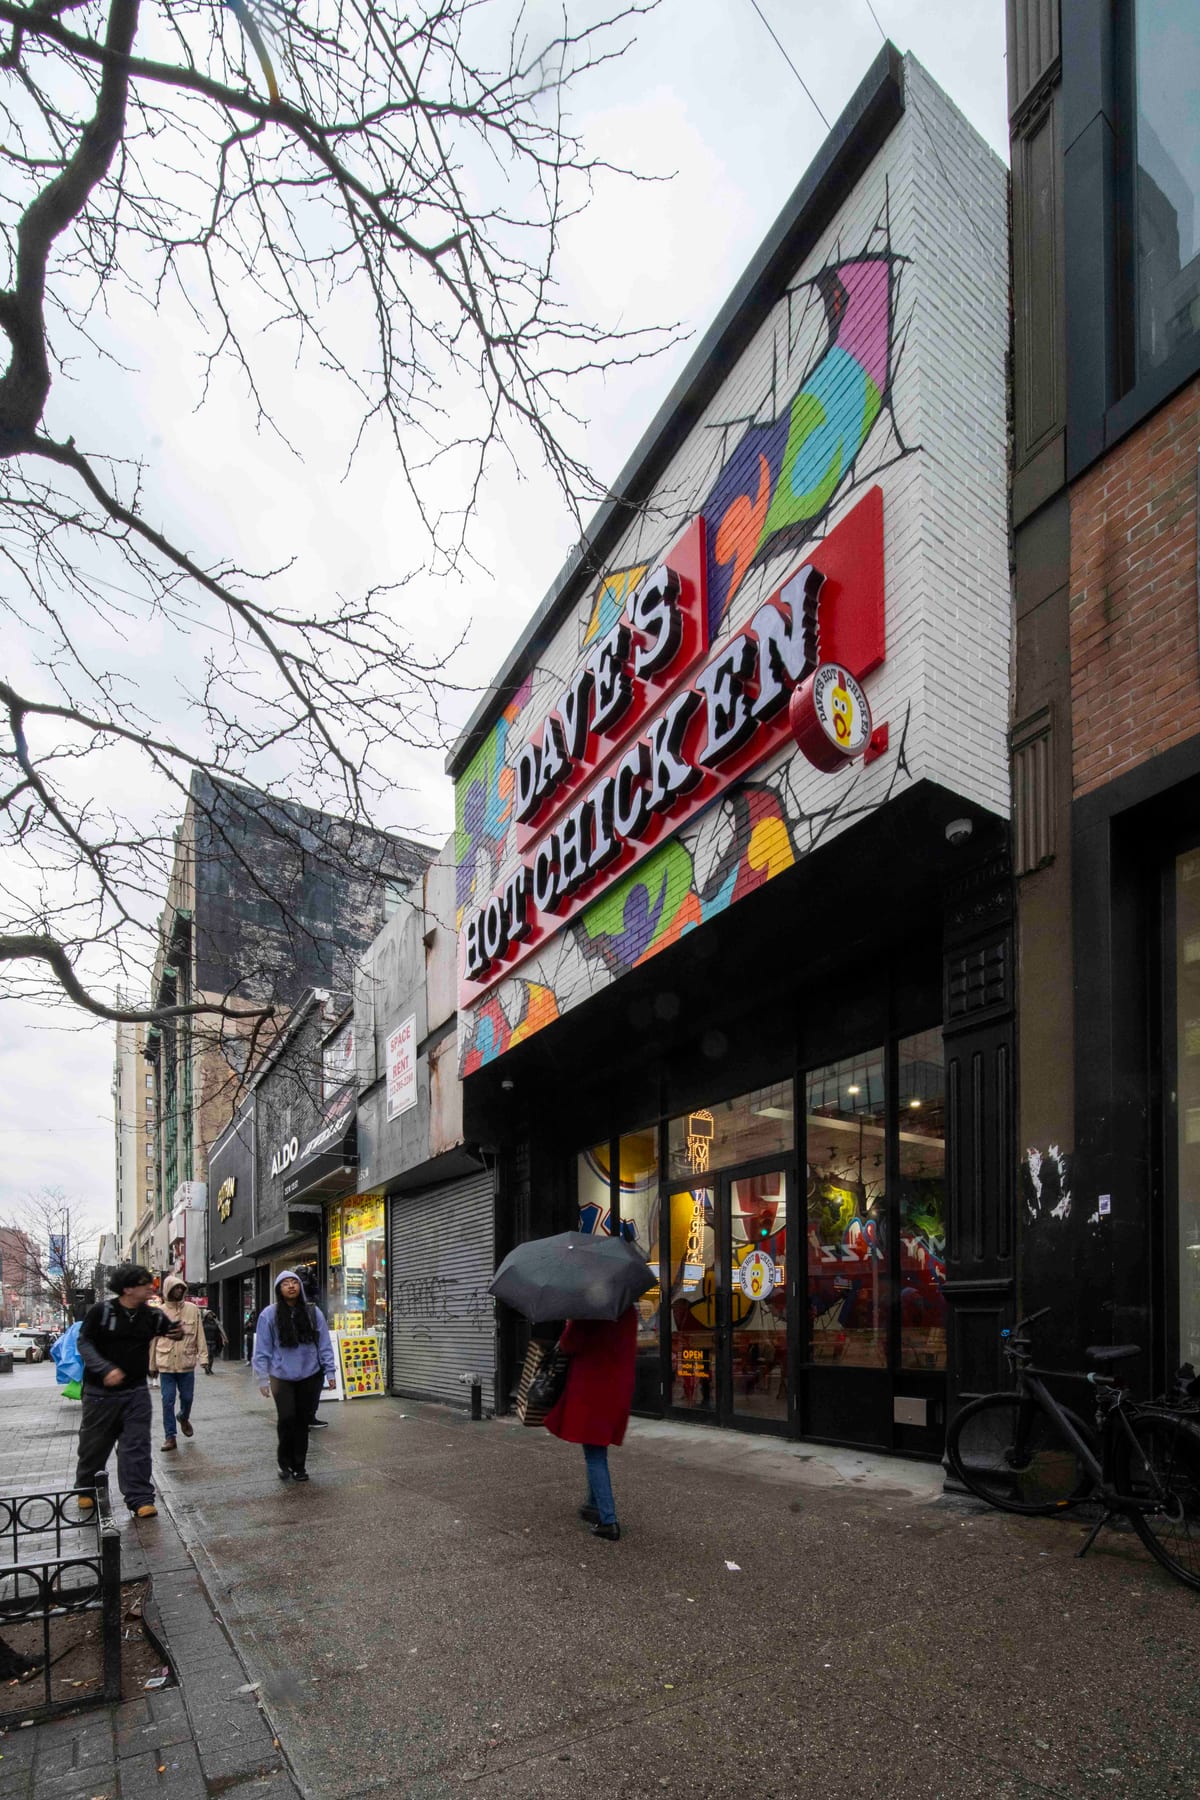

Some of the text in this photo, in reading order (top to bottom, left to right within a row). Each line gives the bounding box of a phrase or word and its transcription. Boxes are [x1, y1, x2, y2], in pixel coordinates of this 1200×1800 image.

[514, 564, 681, 824] DAVE'S
[816, 668, 869, 738] DAVE'S HOT CHICKEN
[464, 564, 825, 981] HOT CHICKEN
[390, 1025, 411, 1053] SPACE
[392, 1056, 410, 1079] RENT
[270, 1136, 299, 1179] ALDO
[682, 1350, 704, 1360] OPEN
